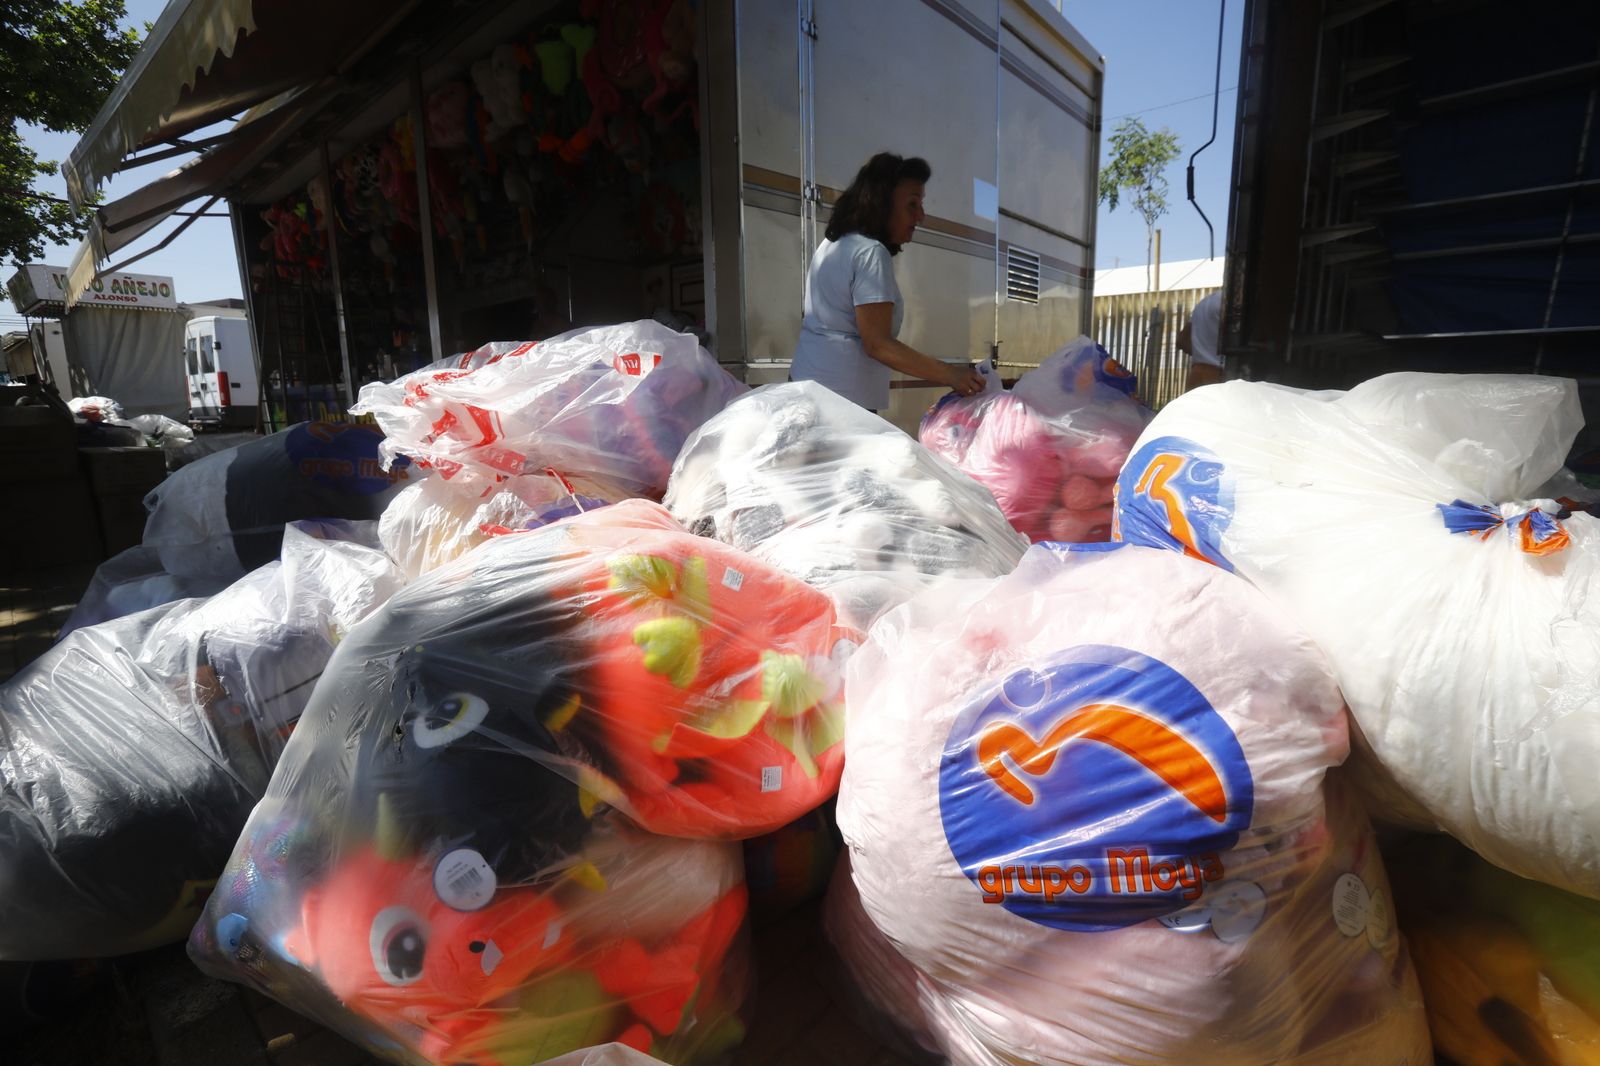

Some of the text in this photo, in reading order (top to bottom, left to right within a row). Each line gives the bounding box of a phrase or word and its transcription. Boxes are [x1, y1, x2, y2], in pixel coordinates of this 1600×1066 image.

[52, 273, 171, 298] VO AÑEJO
[93, 293, 138, 303] ALONSO
[978, 847, 1225, 904] grupo Moya
